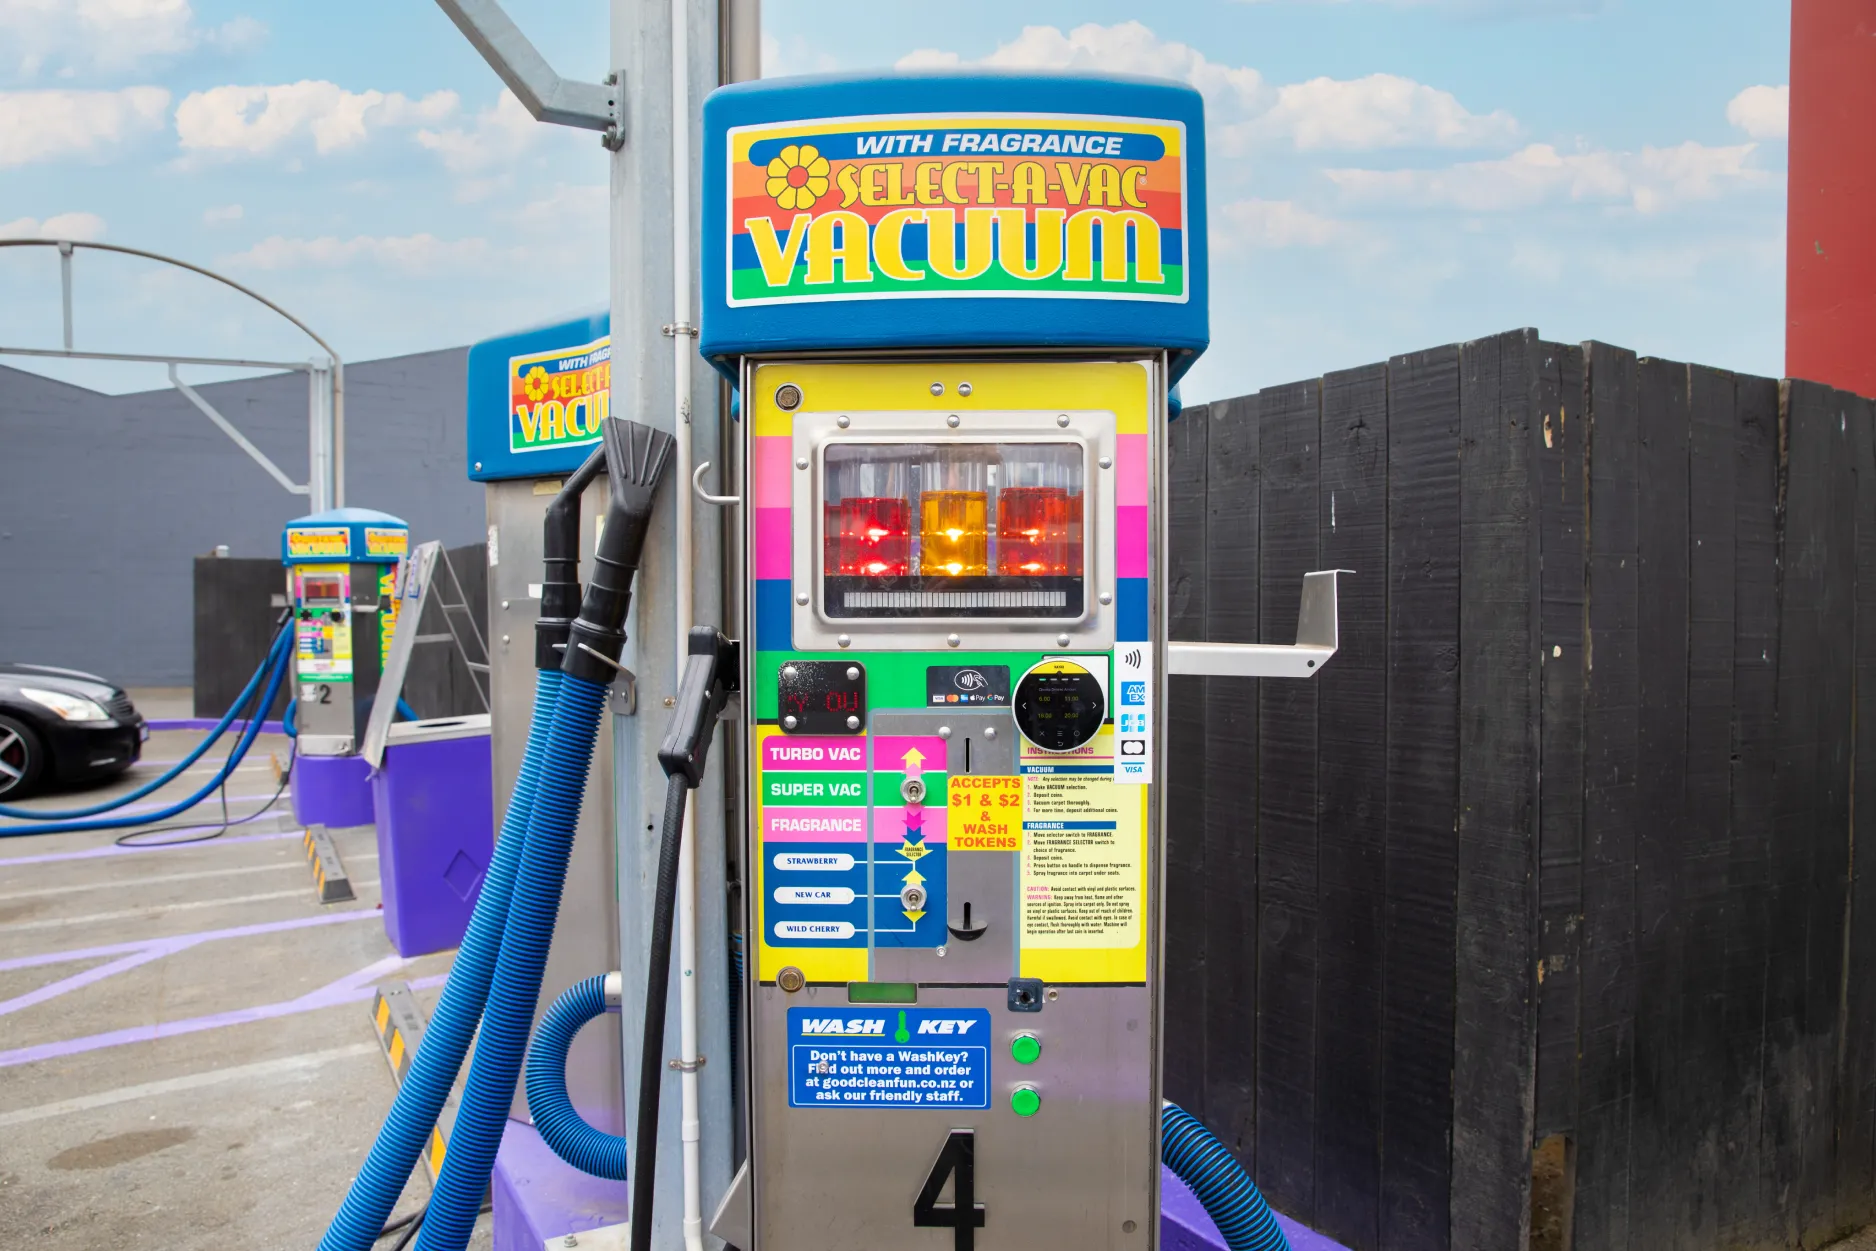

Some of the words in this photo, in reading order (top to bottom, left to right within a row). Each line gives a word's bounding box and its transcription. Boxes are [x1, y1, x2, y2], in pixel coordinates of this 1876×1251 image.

[856, 134, 931, 155] WITH
[942, 133, 1124, 156] FRAGRANCE
[836, 160, 1147, 209] SELECT-A-VAC
[745, 206, 1165, 287] VACUUM
[558, 355, 588, 371] WITH
[319, 684, 332, 705] 2
[770, 747, 824, 761] TURBO
[828, 747, 861, 761] VAC
[771, 783, 824, 796] SUPER
[828, 783, 861, 796] VAC
[951, 778, 1021, 789] ACCEPTS
[952, 793, 971, 808] $1
[980, 794, 992, 807] &
[998, 793, 1020, 808] $2
[980, 811, 991, 822] &
[771, 818, 862, 832] FRAGRANCE
[963, 824, 1008, 835] WASH
[954, 836, 1017, 848] TOKENS
[787, 857, 838, 865] STRAWBERRY
[802, 1019, 886, 1034] WASH
[917, 1019, 977, 1034] KEY
[810, 1050, 847, 1062] Don't
[850, 1050, 883, 1062] have
[886, 1053, 894, 1062] a
[898, 1051, 969, 1065] WashKey?
[840, 1064, 863, 1074] out
[866, 1066, 902, 1075] more
[905, 1064, 931, 1075] and
[934, 1064, 971, 1075] order
[805, 1077, 820, 1087] at
[822, 1077, 956, 1089] goodcleanfun.co.nz
[959, 1080, 974, 1088] or
[816, 1090, 840, 1100] ask
[844, 1092, 867, 1100] our
[869, 1090, 923, 1103] friendly
[926, 1090, 963, 1101] staff.
[914, 1128, 985, 1251] 4
